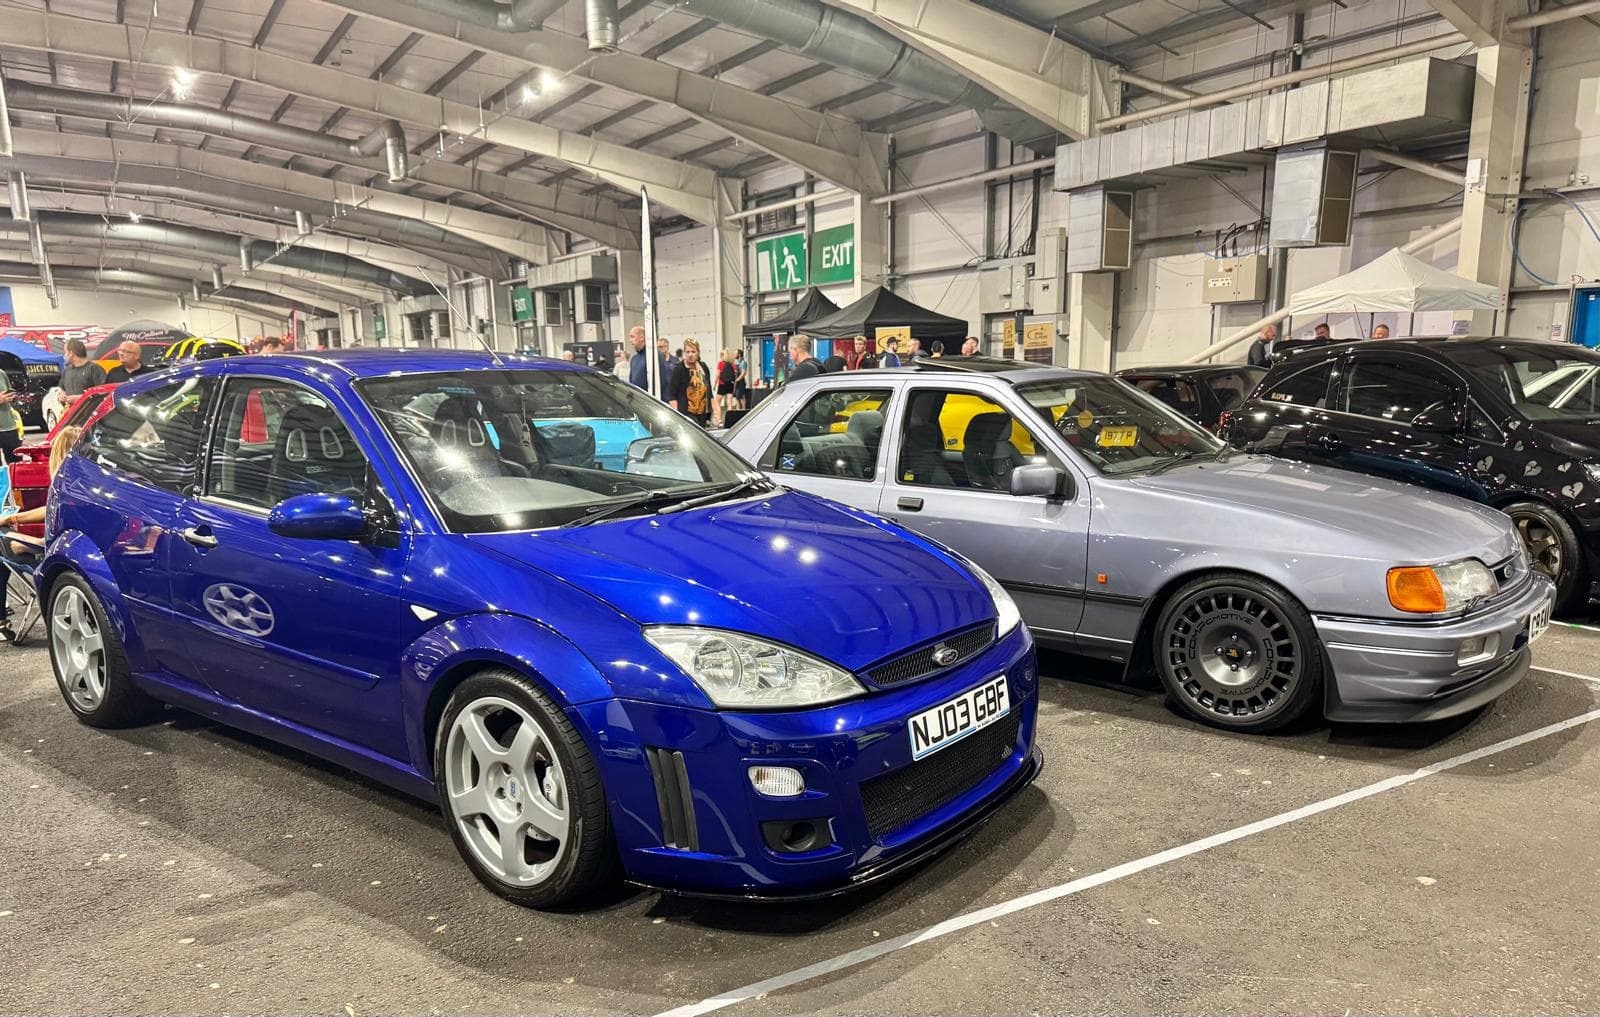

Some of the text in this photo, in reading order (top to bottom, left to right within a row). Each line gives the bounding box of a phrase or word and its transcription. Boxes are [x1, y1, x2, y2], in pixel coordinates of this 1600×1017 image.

[822, 241, 853, 269] EXIT
[1189, 613, 1254, 659] COMPOMOTIVE
[1220, 638, 1274, 696] COMPOMOTIVE
[912, 680, 1005, 752] NJ03 GBF
